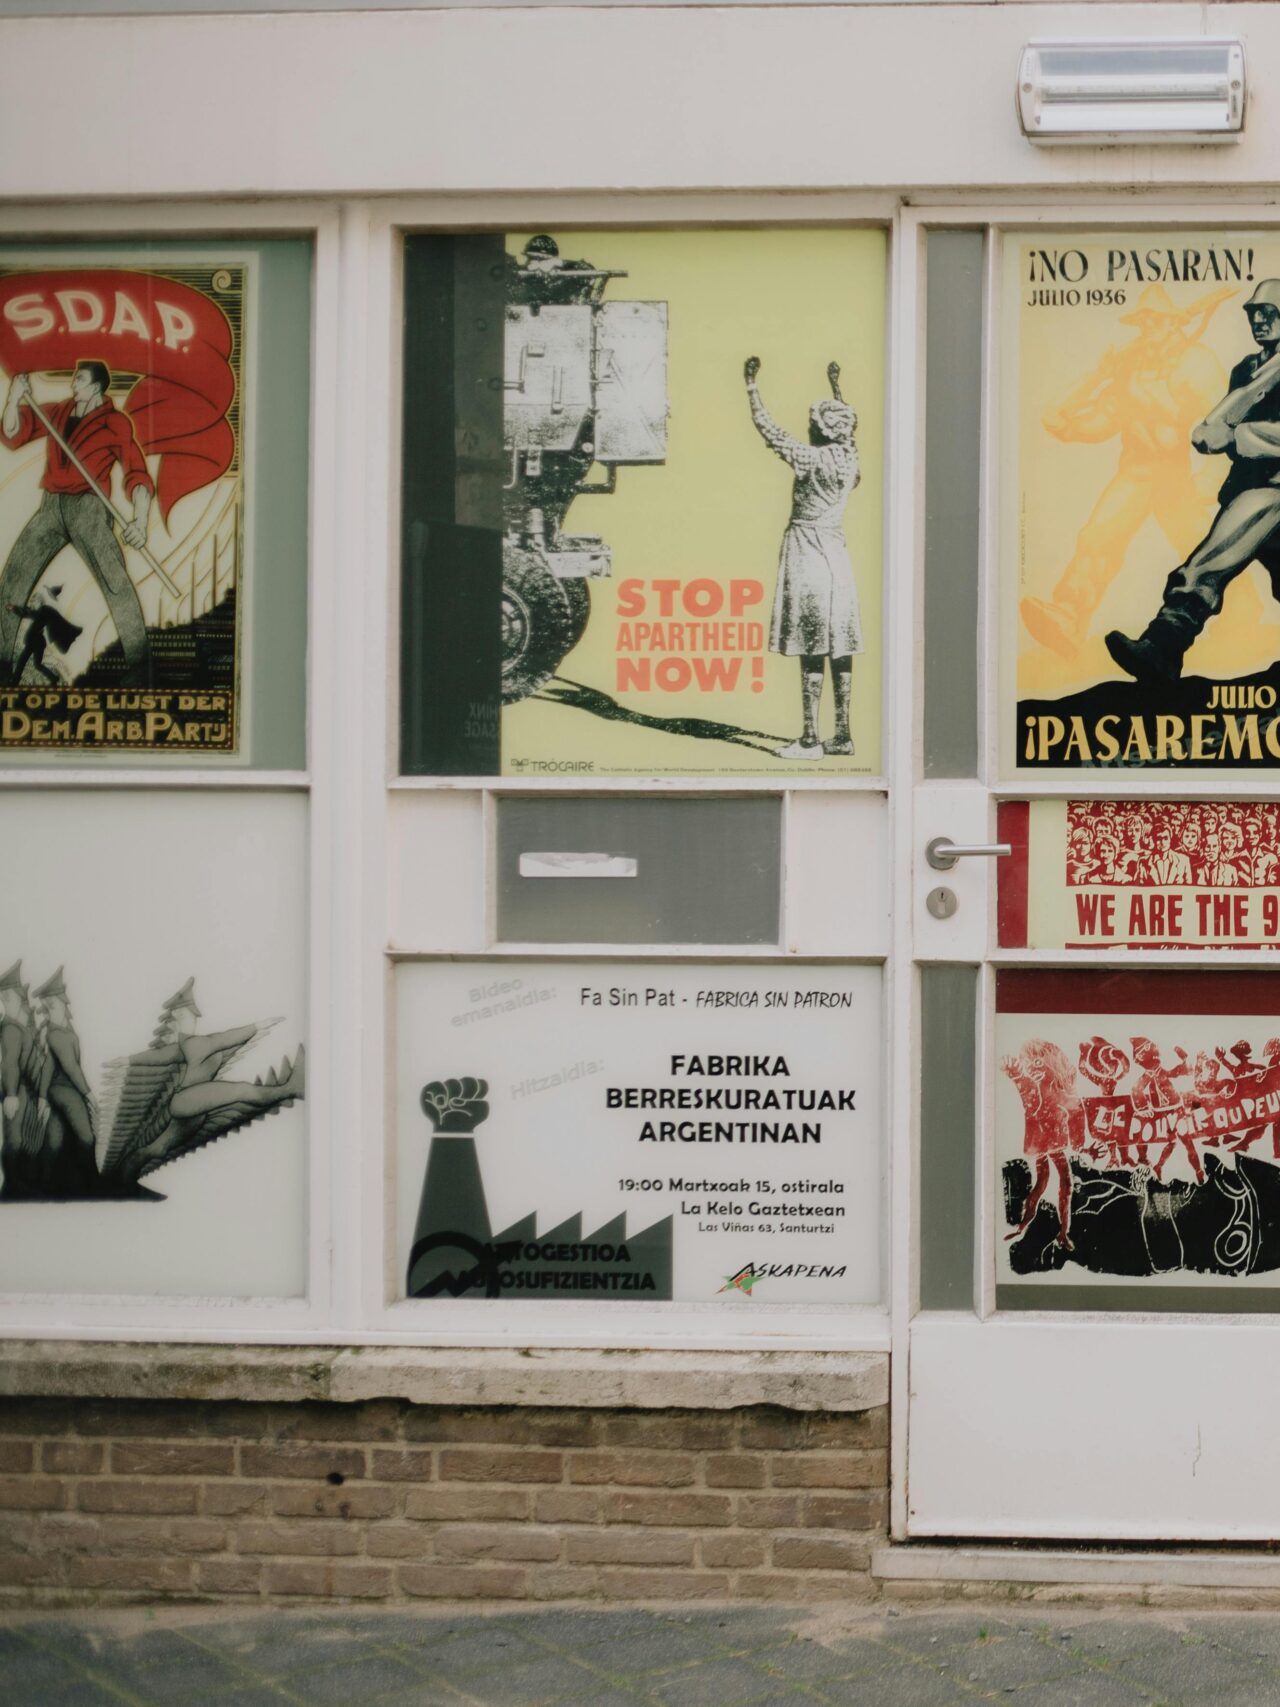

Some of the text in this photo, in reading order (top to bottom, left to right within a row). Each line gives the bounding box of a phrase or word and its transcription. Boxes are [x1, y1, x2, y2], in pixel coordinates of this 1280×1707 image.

[1029, 243, 1254, 282] ¡NO PASARÁN!
[1027, 288, 1126, 306] JULIO 1936
[3, 290, 195, 353] S.D.A.P.
[616, 578, 764, 617] STOP
[616, 622, 763, 652] APARTHEID
[26, 694, 60, 709] OP
[67, 694, 100, 710] DE
[106, 695, 172, 711] LIJST
[178, 695, 226, 711] DER
[1206, 685, 1277, 709] JULIO
[1076, 894, 1115, 937] WE
[1129, 895, 1182, 937] ARE
[1196, 895, 1248, 937] THE
[581, 988, 601, 1006] Fa
[609, 987, 638, 1006] Sin
[645, 988, 675, 1006] Pat
[696, 991, 758, 1008] FABRICA
[764, 991, 789, 1007] SIN
[794, 991, 853, 1008] PATRON
[671, 1055, 790, 1077] FABRIKA
[605, 1088, 856, 1111] BERRESKURATUAK
[638, 1122, 822, 1144] ARGENTINAN
[619, 1178, 844, 1194] 19:00 Martxoak 15, ostirala
[681, 1201, 845, 1216] La Kelo Gaztetxean
[699, 1222, 718, 1232] Las
[722, 1222, 754, 1232] Viñas
[780, 1222, 834, 1233] Santurtzi
